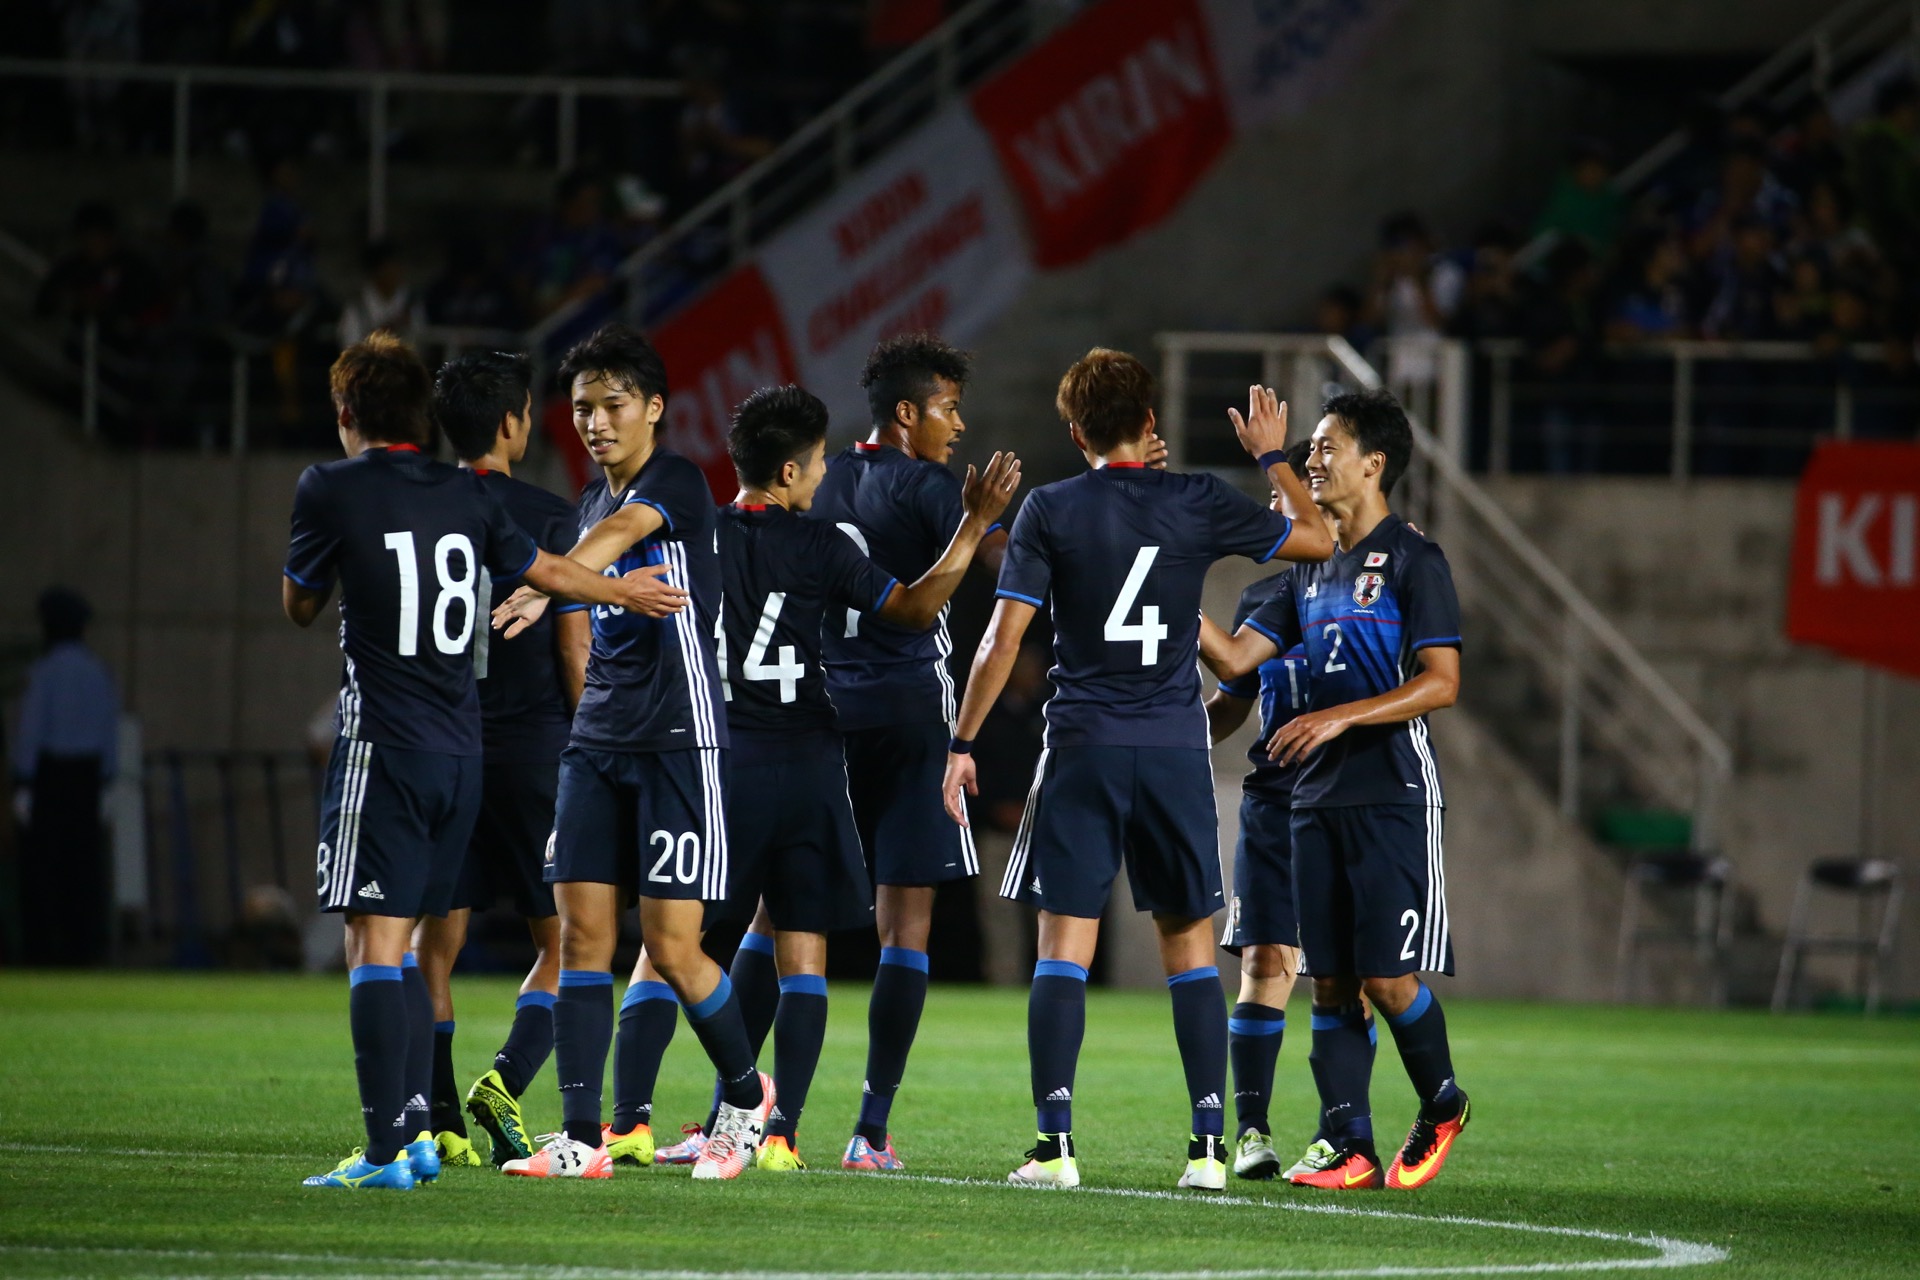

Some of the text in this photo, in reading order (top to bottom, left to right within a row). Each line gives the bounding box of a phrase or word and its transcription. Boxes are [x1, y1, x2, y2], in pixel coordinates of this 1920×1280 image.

[1010, 17, 1207, 212] KIRIN
[384, 530, 477, 657] 18
[1103, 546, 1168, 667] 4
[1322, 622, 1347, 674] 2
[1284, 658, 1309, 710] 1
[648, 829, 701, 885] 20
[1400, 908, 1420, 961] 2
